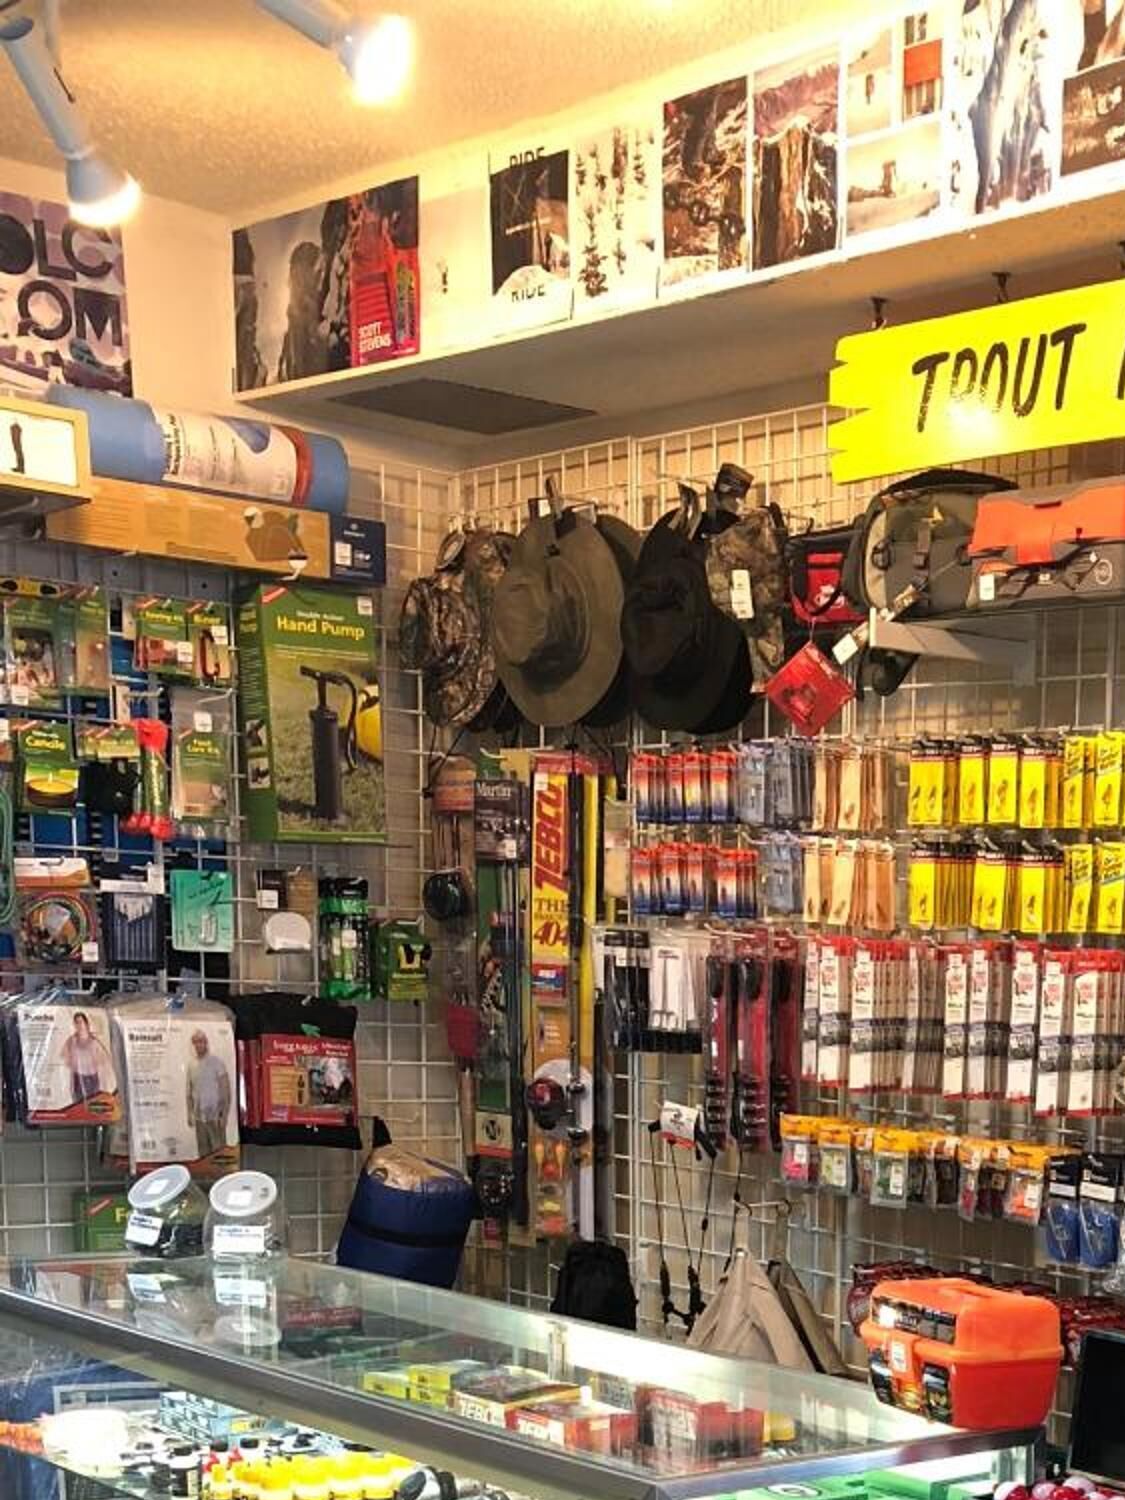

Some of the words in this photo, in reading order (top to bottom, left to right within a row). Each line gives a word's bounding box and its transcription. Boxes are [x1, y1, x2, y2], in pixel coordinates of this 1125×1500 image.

[359, 321, 383, 339] SCOTT
[359, 334, 392, 354] STEVENS
[911, 322, 1088, 433] TROUT
[277, 615, 317, 633] Hand
[321, 620, 365, 640] Pump
[476, 782, 511, 798] Martin
